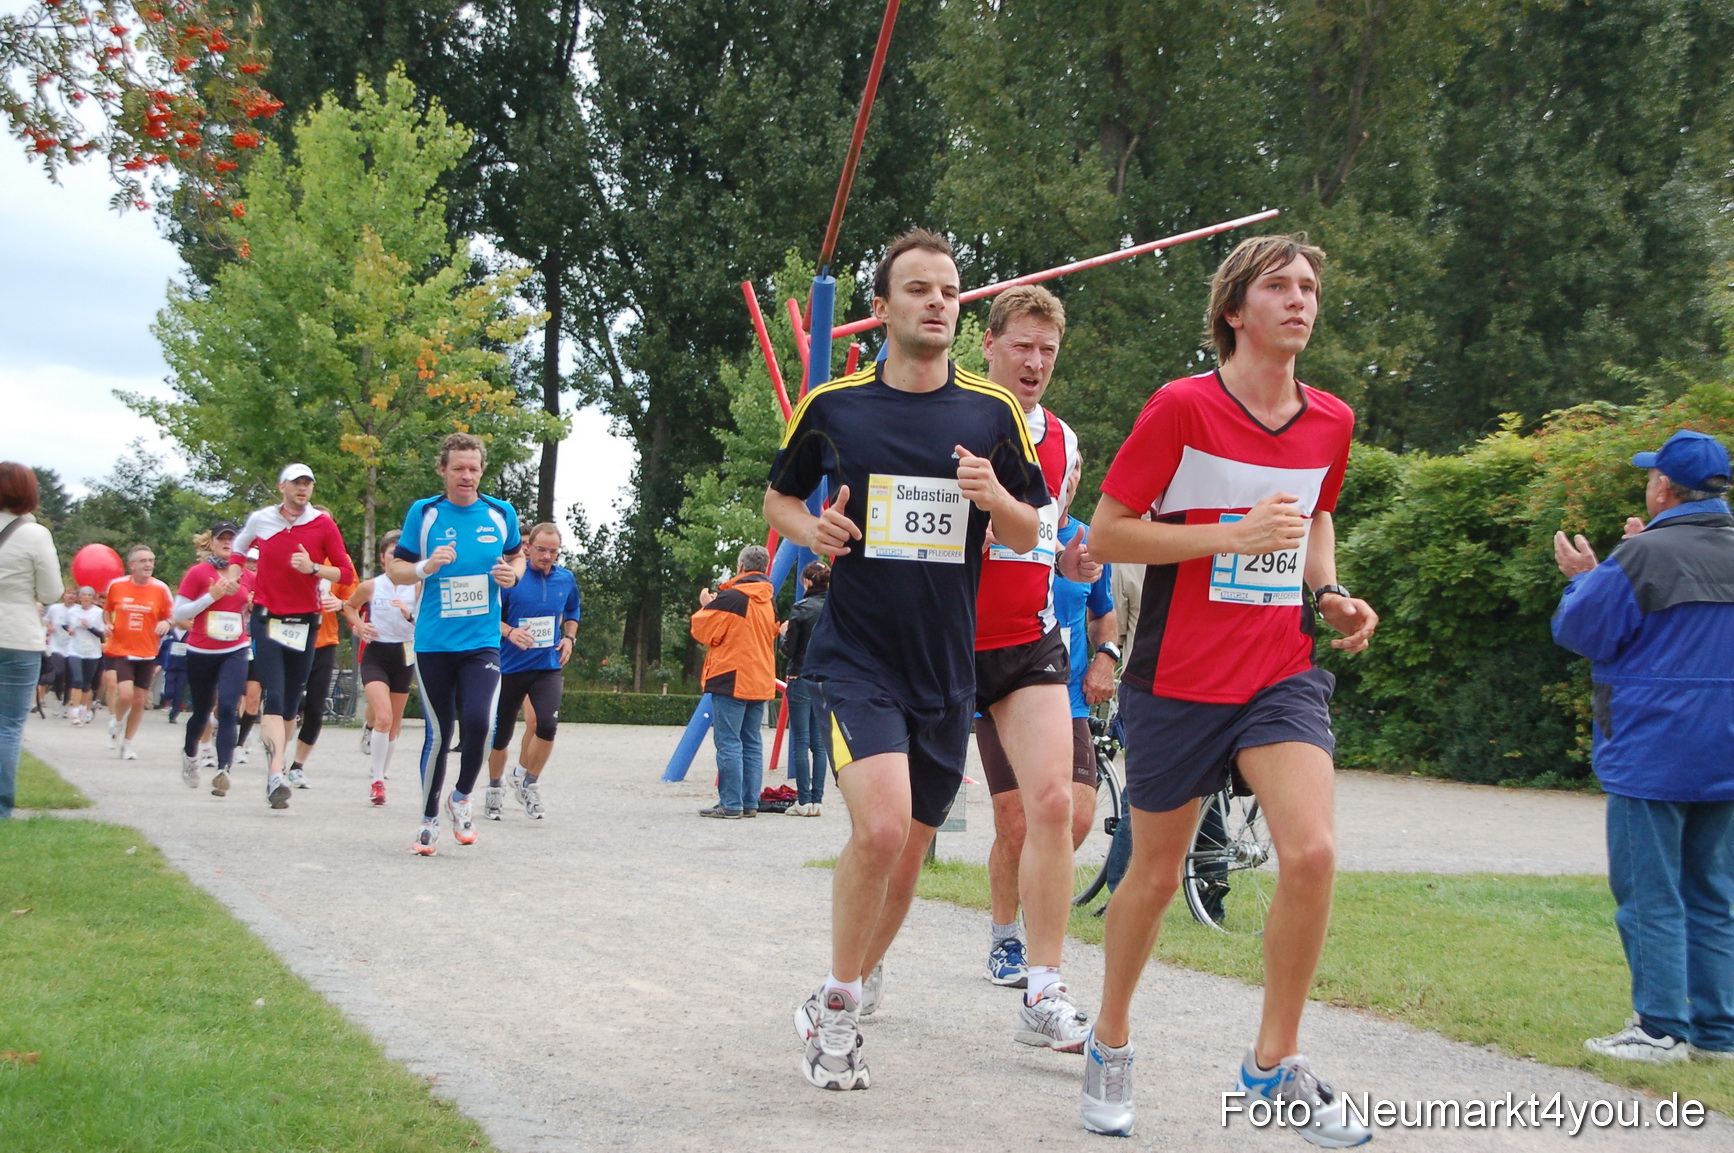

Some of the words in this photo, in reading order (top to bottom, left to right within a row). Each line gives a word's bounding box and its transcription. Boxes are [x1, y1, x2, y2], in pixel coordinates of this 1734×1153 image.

[897, 485, 960, 504] Sebastian
[872, 507, 878, 519] C
[905, 511, 952, 535] 835
[928, 549, 963, 558] PFLEIDERER
[1244, 552, 1298, 574] 2964
[454, 591, 483, 603] 2306
[1272, 592, 1300, 600] PFLEIDERER
[224, 623, 235, 632] 69
[531, 628, 552, 638] 2286
[282, 629, 300, 640] 497
